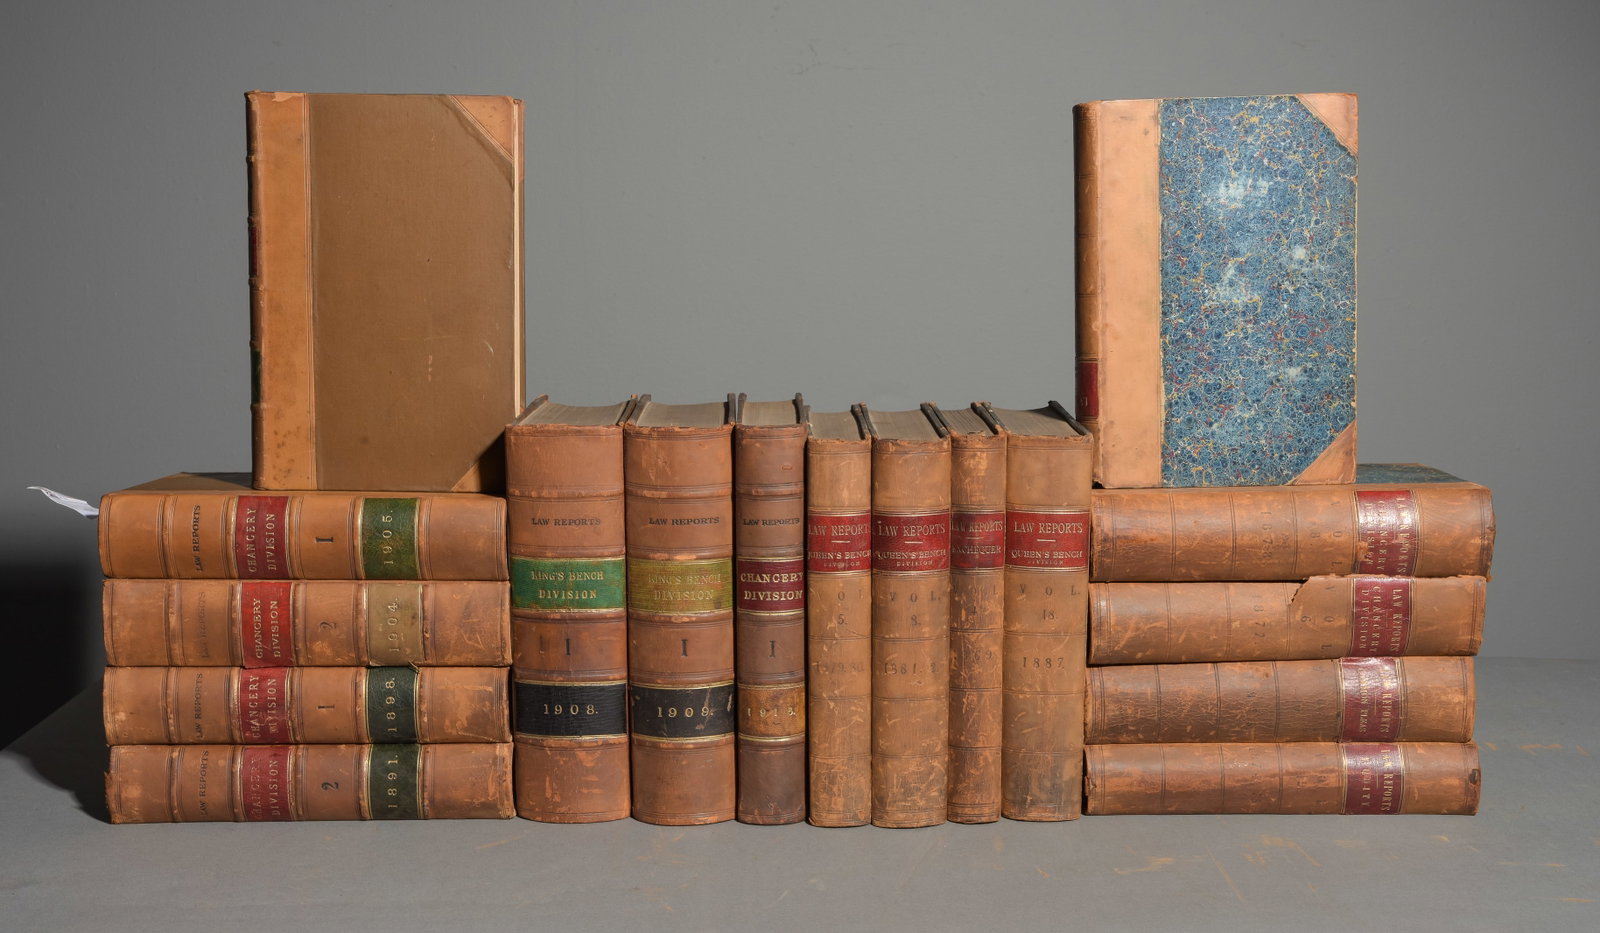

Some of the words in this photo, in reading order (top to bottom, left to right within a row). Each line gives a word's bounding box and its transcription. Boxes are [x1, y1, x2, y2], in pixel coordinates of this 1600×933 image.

[192, 504, 202, 549] REPORTS
[531, 517, 550, 526] LAW
[553, 517, 602, 527] REPORTS
[648, 517, 668, 526] LAW
[671, 516, 720, 527] REPORTS
[742, 518, 760, 526] LAW
[761, 517, 801, 526] REPORTS
[808, 525, 827, 537] LAW
[831, 523, 872, 537] REPORT
[969, 520, 1003, 533] REPORTS
[1013, 521, 1034, 534] LAW
[1038, 522, 1083, 534] REPORTS
[878, 524, 899, 537] LAW
[902, 523, 946, 538] REPORTS
[246, 508, 258, 573] CHANCERY
[265, 512, 278, 571] DIVISION
[1396, 524, 1410, 573] REPORTS
[876, 551, 917, 561] QUEEN'S
[918, 549, 947, 560] BENCH
[1011, 550, 1050, 559] QUEEN'S
[1052, 550, 1083, 559] BENCH
[192, 556, 204, 572] LAW
[568, 571, 605, 581] BENCH
[740, 571, 804, 584] CHANCERY
[538, 589, 597, 600] DIVISION
[654, 590, 714, 601] DIVISION
[743, 589, 804, 601] DIVISION
[1392, 588, 1403, 608] LAW
[1359, 589, 1370, 649] DIVISION
[1368, 585, 1382, 654] CHANCERY
[253, 598, 264, 659] CHANCERY
[270, 600, 281, 658] DIVISION
[1391, 613, 1403, 653] REPORTS
[194, 673, 204, 720] REPORTS
[249, 675, 261, 738] CHANCERY
[1380, 693, 1393, 733] REPORTS
[200, 750, 210, 798] REPORTS
[268, 759, 281, 816] DIVISION
[321, 781, 340, 791] 2
[1380, 773, 1394, 812] REPORTS
[200, 799, 209, 816] LAW
